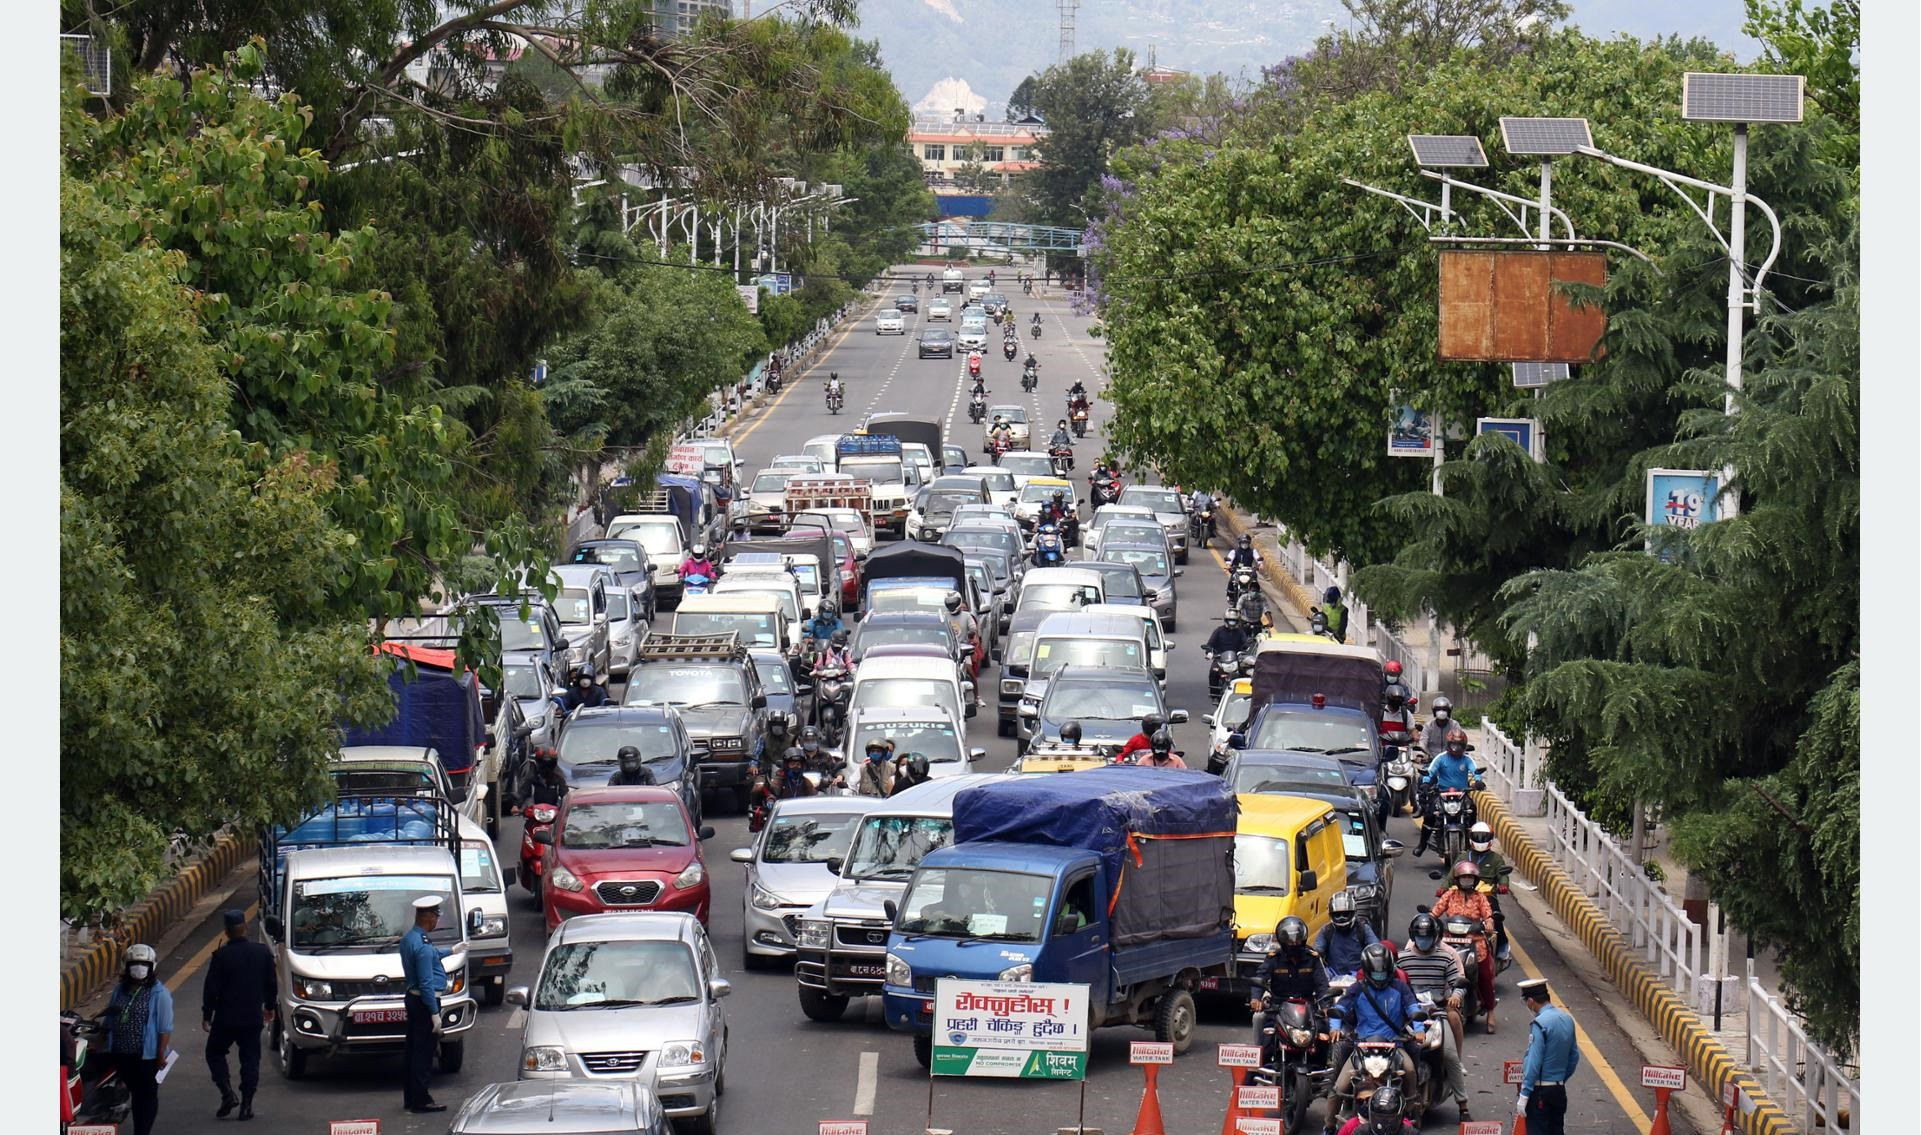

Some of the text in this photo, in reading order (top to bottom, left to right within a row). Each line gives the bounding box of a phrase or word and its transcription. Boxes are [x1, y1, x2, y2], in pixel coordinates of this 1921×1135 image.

[955, 991, 1058, 1018] रोक्नुहोस्
[946, 1018, 978, 1032] प्रहरी
[1045, 1052, 1078, 1070] शिवम्
